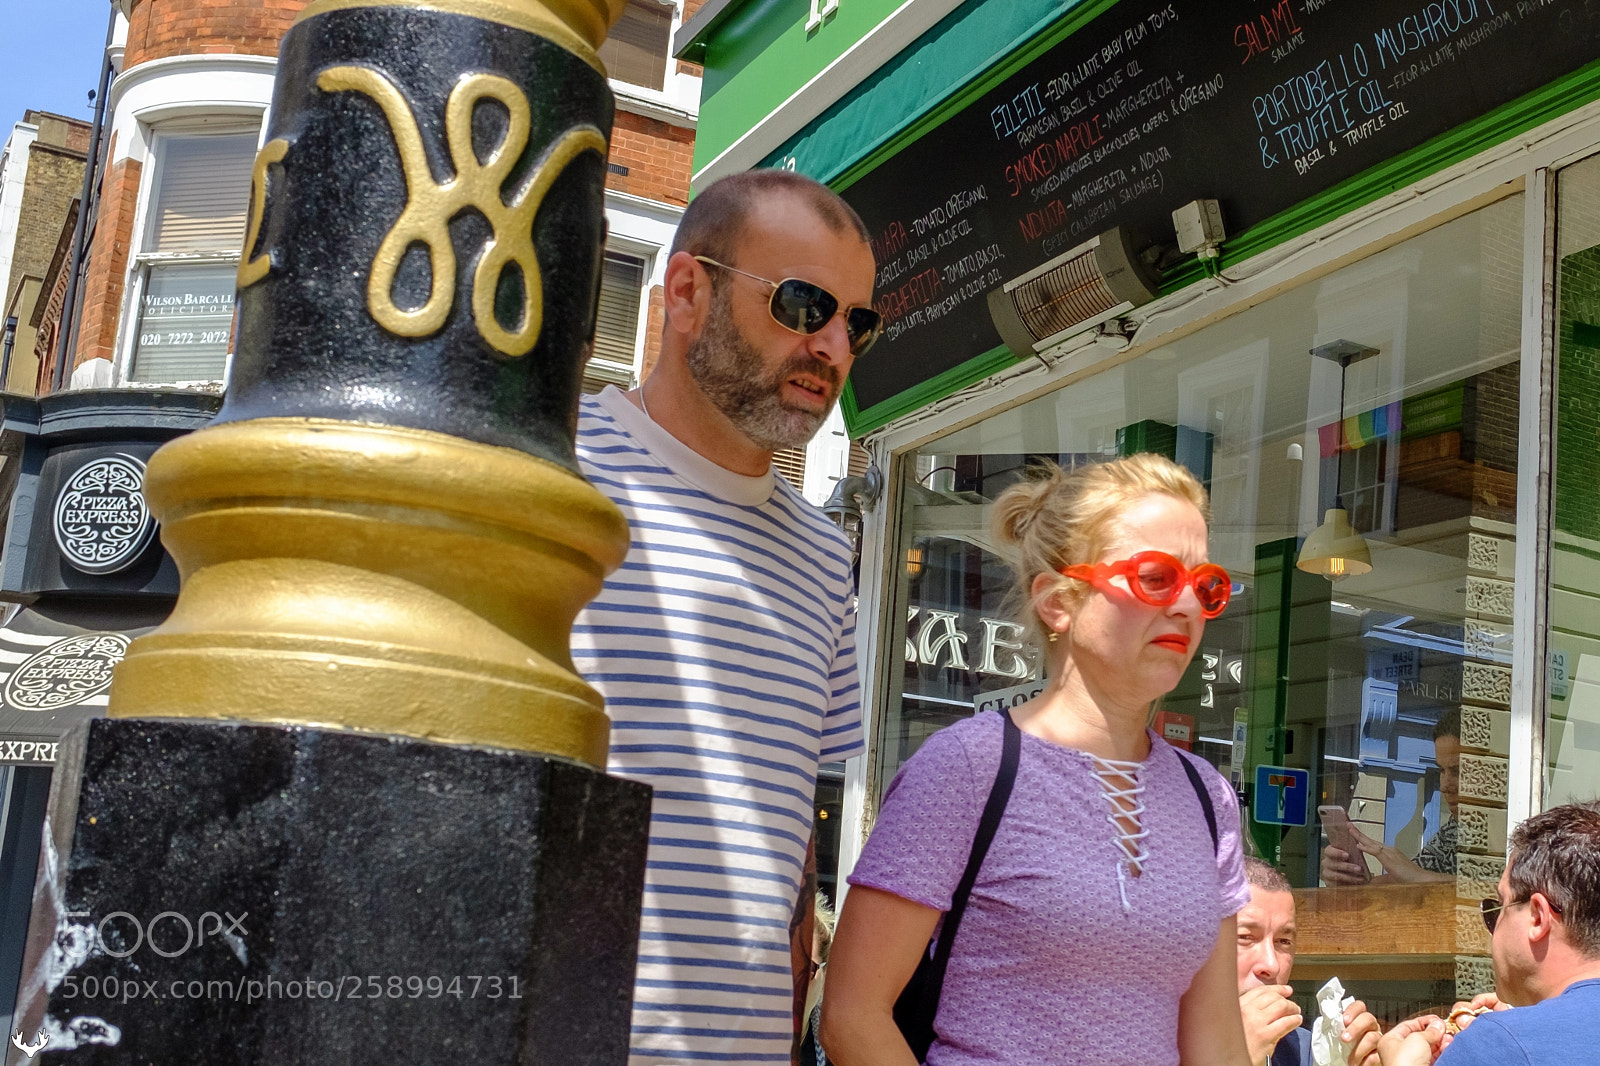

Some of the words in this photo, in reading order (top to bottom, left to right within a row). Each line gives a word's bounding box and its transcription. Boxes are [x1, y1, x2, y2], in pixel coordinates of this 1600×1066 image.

[1234, 0, 1301, 65] SALAMI
[1271, 31, 1306, 64] SALAMI
[990, 82, 1046, 140] FILETTI
[1101, 35, 1124, 64] BABY
[1125, 22, 1148, 50] PLUM
[1060, 97, 1088, 122] BASIL
[1087, 90, 1097, 107] &
[1096, 69, 1124, 99] OLIVE
[1127, 60, 1143, 78] OIL
[1142, 110, 1169, 134] CAPERS
[1170, 99, 1180, 116] &
[1179, 73, 1224, 112] OREGANO
[1252, 43, 1368, 133] PORTOBELLO
[1259, 136, 1280, 169] &
[1275, 93, 1355, 160] TRUFFLE
[1358, 79, 1393, 114] OIL
[1295, 148, 1325, 176] BASIL
[1328, 140, 1338, 156] &
[1342, 114, 1387, 147] TRUFFLE
[1389, 101, 1410, 121] OIL
[1005, 143, 1057, 197] SMOKED
[1056, 114, 1104, 161] NAPOLI
[906, 243, 932, 270] BASIL
[930, 237, 939, 254] &
[938, 224, 959, 247] OLIVE
[958, 219, 973, 236] OIL
[925, 290, 961, 322] PARMESAN
[966, 274, 987, 298] OLIVE
[988, 267, 1003, 285] OIL
[140, 333, 161, 346] 020
[168, 332, 194, 345] 7272
[199, 331, 227, 344] 2072
[64, 509, 139, 524] EXPRESS
[80, 496, 128, 510] PIZZA
[23, 668, 112, 680] EXPRESS
[48, 658, 104, 670] PIZZA
